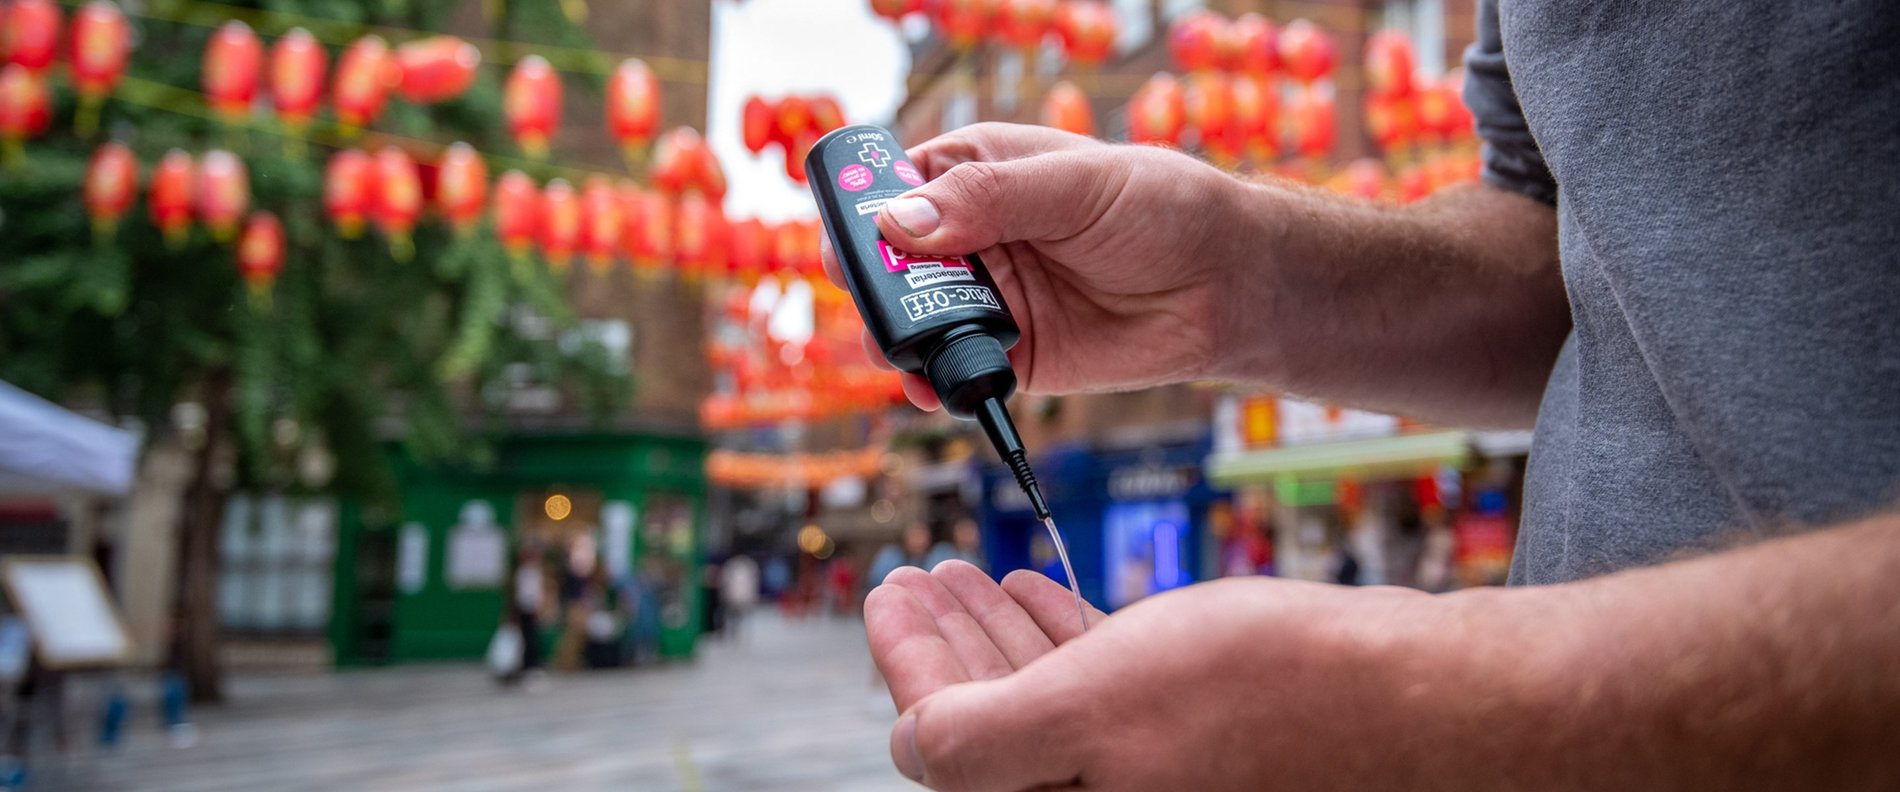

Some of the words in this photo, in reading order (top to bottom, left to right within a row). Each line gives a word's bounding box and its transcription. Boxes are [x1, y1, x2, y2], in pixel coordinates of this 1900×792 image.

[858, 132, 884, 142] 50ml
[910, 269, 970, 285] antibacterial
[906, 288, 996, 317] Muc-Off
